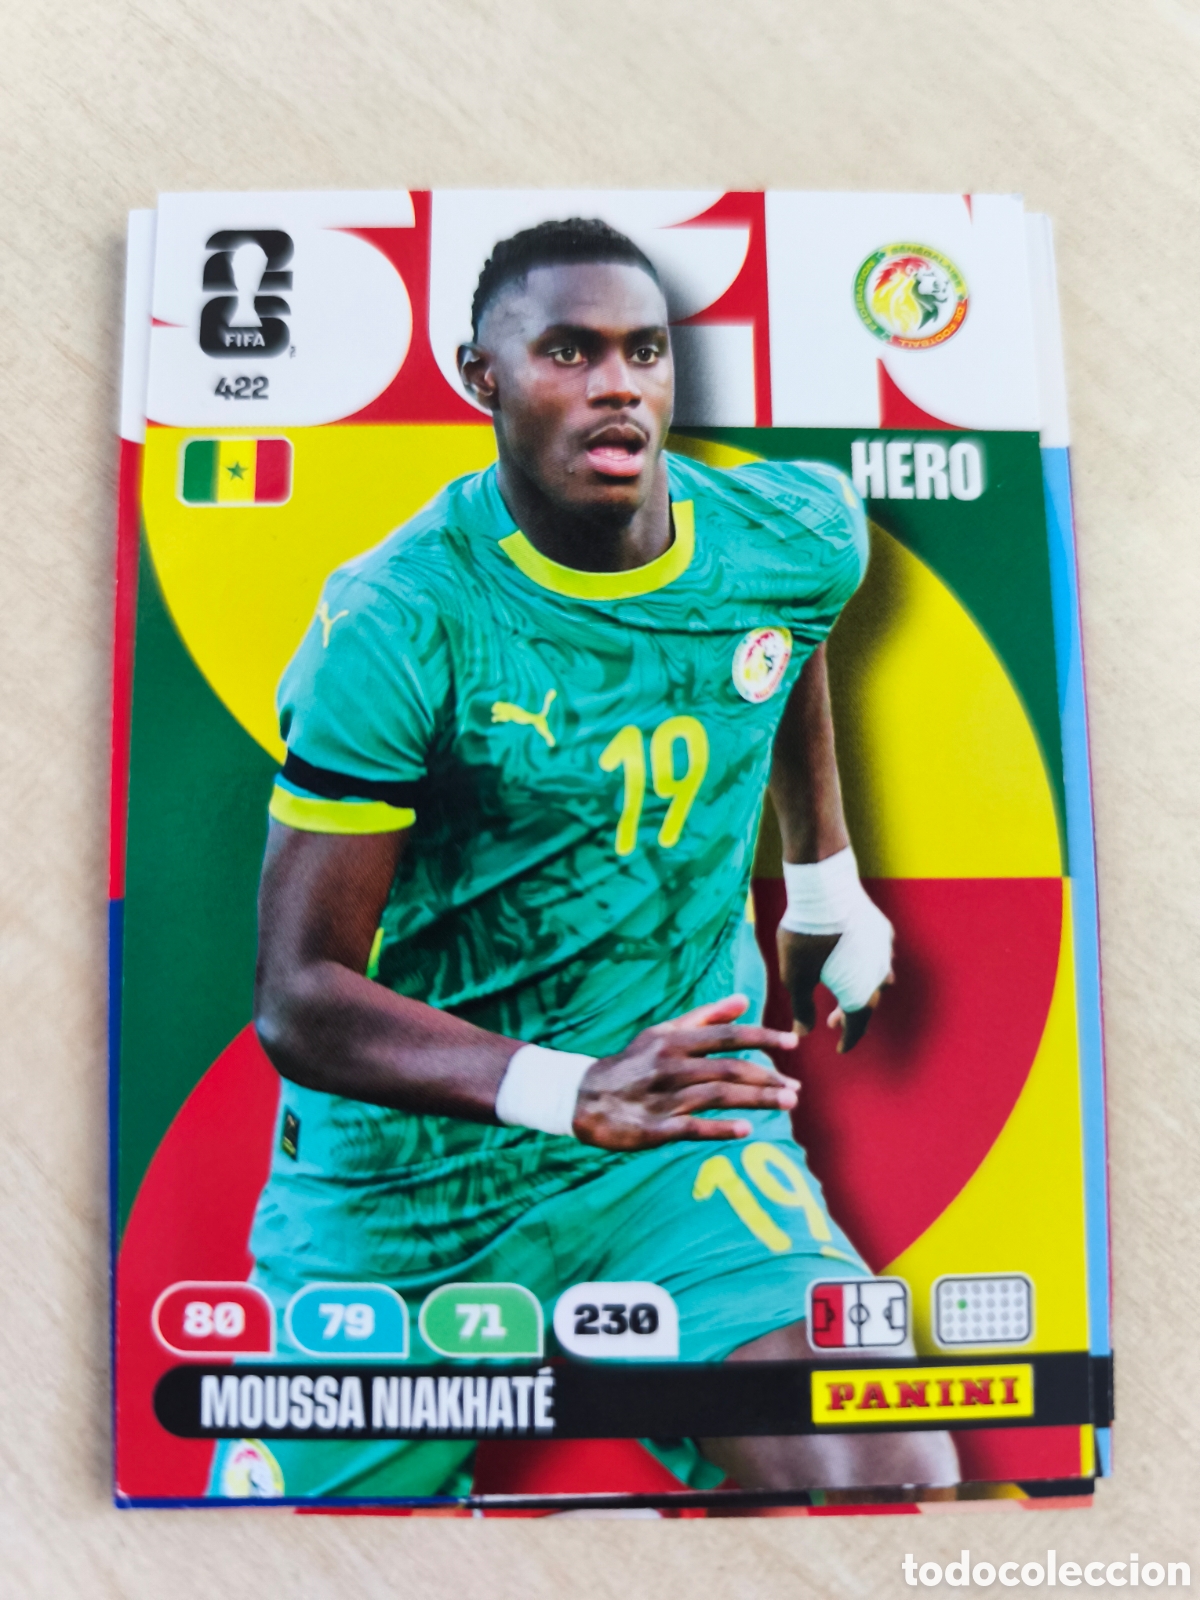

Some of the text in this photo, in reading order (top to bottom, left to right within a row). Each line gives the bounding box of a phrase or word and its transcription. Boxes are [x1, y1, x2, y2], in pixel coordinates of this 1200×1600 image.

[225, 333, 266, 347] FIFA
[899, 324, 957, 348] FOOTBALL
[214, 376, 270, 400] 422
[851, 442, 983, 501] HERO
[599, 715, 709, 856] 19
[692, 1142, 832, 1253] 19
[183, 1302, 246, 1338] 80
[319, 1303, 375, 1338] 79
[455, 1303, 505, 1338] 71
[574, 1303, 660, 1335] 230
[201, 1367, 555, 1429] MOUSSA NIAKHATÉ
[826, 1377, 1020, 1411] PANINI
